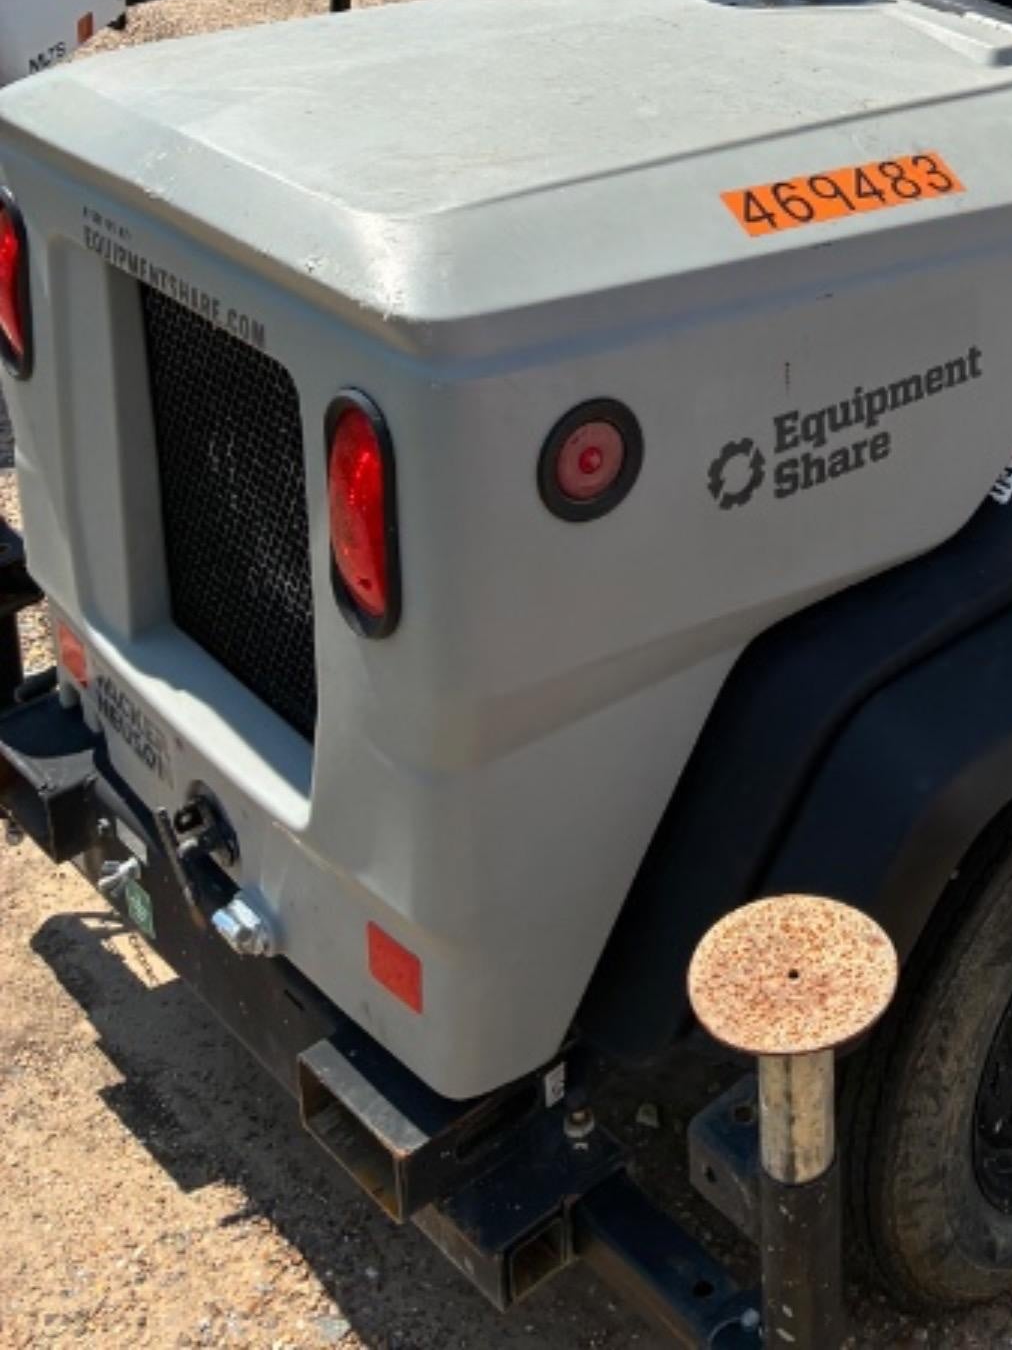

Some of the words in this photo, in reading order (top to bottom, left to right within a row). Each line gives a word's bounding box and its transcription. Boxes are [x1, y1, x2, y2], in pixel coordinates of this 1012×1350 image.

[743, 154, 954, 229] 469483
[82, 223, 267, 348] EQUIPMENTSHARE.COM
[772, 345, 983, 454] Equipment
[772, 431, 892, 500] Share
